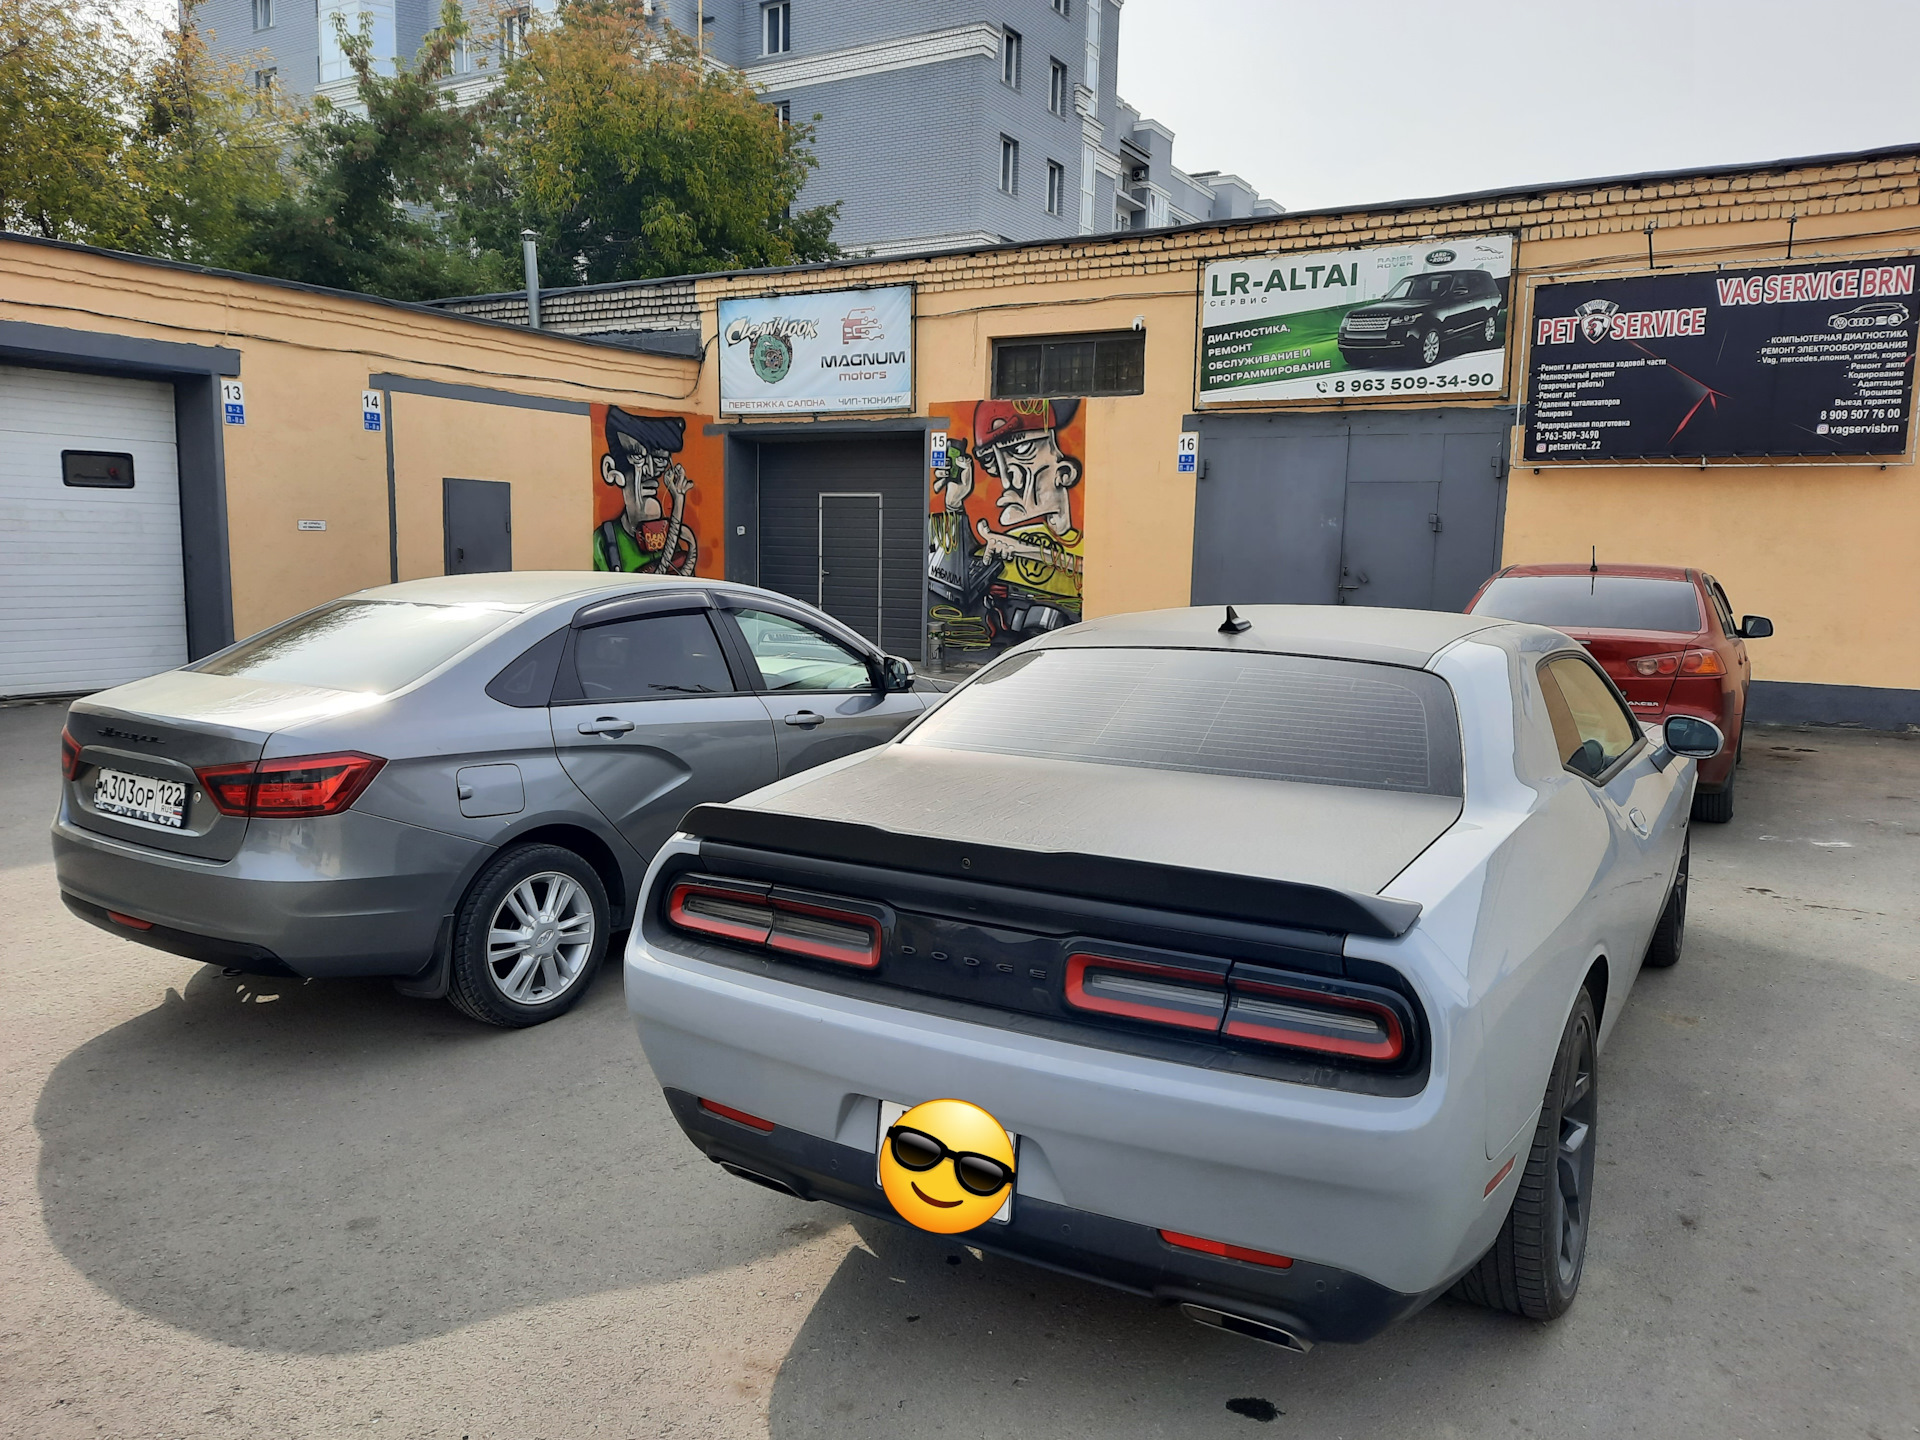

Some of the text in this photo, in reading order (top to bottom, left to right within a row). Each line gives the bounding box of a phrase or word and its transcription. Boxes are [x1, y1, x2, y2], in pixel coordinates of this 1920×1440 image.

[1377, 261, 1413, 269] ROVER
[1211, 263, 1358, 296] LR-ALTAI
[1716, 264, 1915, 306] VAG SERVICE BRN
[1210, 296, 1268, 307] СЕРВИС
[779, 317, 819, 341] LOOK
[1537, 307, 1707, 346] PET SERVICE
[1207, 324, 1291, 345] ДИАГНОСТИКА,
[1771, 330, 1908, 344] КОМПЬЮТЕРНАЯ ДИАГНОСТИКА
[1208, 343, 1253, 357] РЕМОНТ
[1761, 341, 1908, 355] РЕМОНТ ЭЛЕКТРООБОРУДОВАНИЯ
[821, 350, 905, 368] MAGNUM
[1208, 348, 1311, 371] ОБСЛУЖИВАНИЕ И
[1571, 362, 1615, 371] диагностика
[1616, 358, 1645, 367] ходовой
[1647, 358, 1667, 366] части
[1762, 356, 1778, 365] Vag,
[1853, 352, 1880, 361] китай,
[1881, 351, 1907, 361] корея
[1209, 360, 1331, 384] ПРОГРАММИРОВАНИЕ
[1850, 362, 1882, 370] Ремонт
[839, 371, 887, 381] motors
[1591, 371, 1615, 380] ремонт
[1848, 371, 1904, 379] Кодирование
[1334, 373, 1494, 393] 8 963 509-34-90
[1538, 379, 1604, 392] (сварочные работы)
[223, 385, 242, 401] 13
[1859, 388, 1902, 397] Прошивка
[363, 395, 379, 409] 14
[728, 399, 825, 409] ПЕРЕТЯЖКА САЛОНА
[838, 395, 902, 406] ЧИП-ТЮНИНГ
[1571, 398, 1620, 408] катализаторов
[1834, 397, 1902, 407] Выезд гарантия
[1820, 408, 1901, 420] 8 909 507 76 00
[1591, 419, 1630, 429] подготовка
[1830, 423, 1899, 436] vagservisbrn
[932, 435, 945, 448] 15
[1536, 430, 1599, 441] 8-963-509-3490
[1179, 437, 1195, 451] 16
[1548, 441, 1602, 453] petservice_22
[931, 565, 962, 586] MAGNUM
[158, 784, 182, 806] 122
[161, 805, 173, 814] RUS
[901, 945, 1047, 979] DODGE
